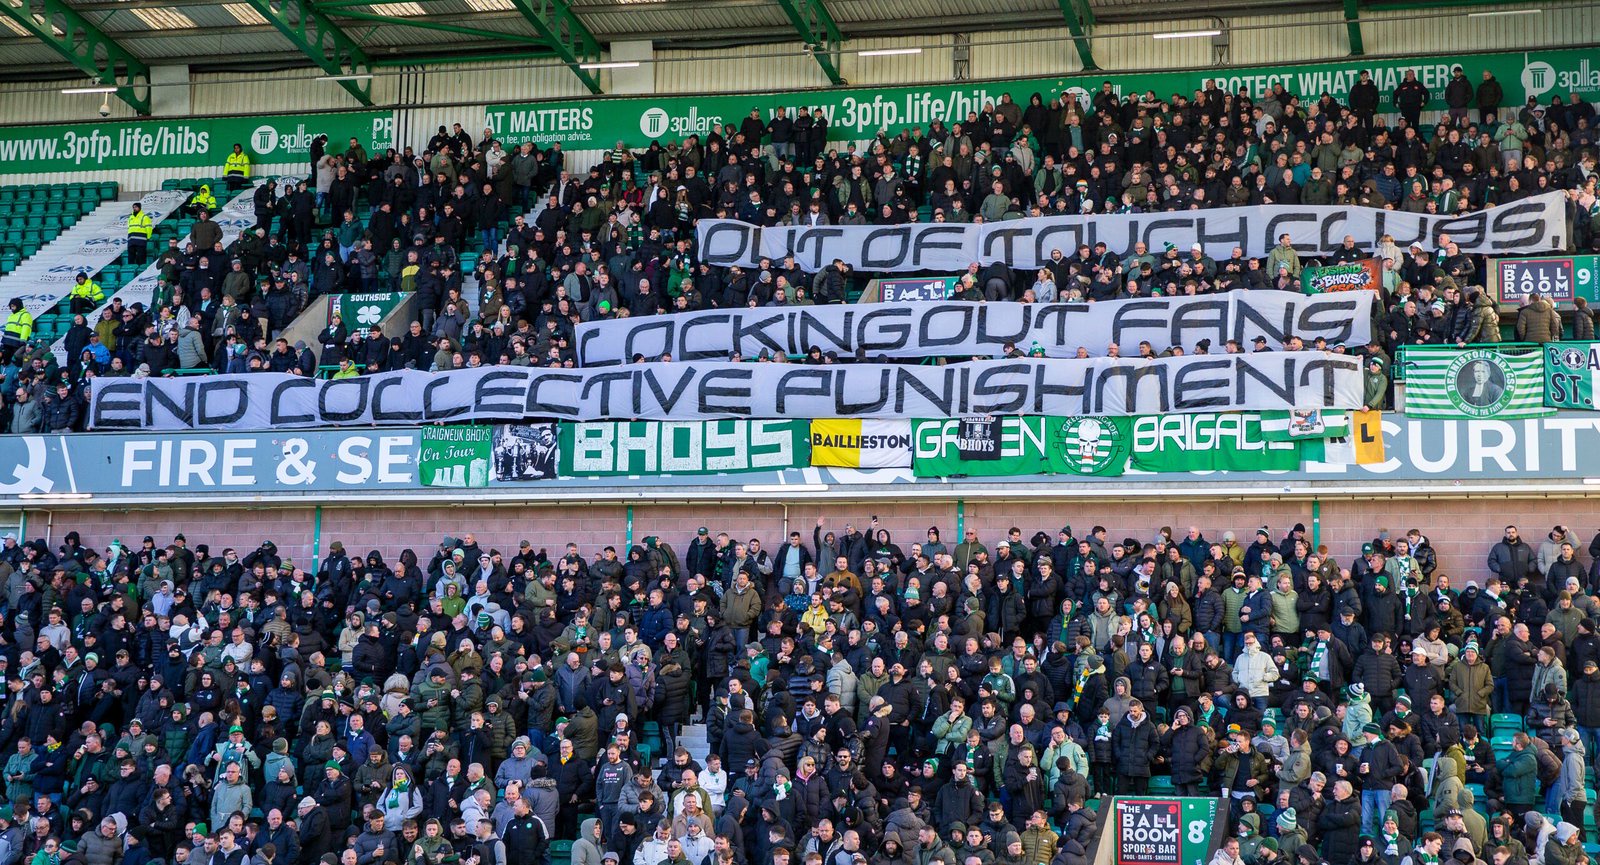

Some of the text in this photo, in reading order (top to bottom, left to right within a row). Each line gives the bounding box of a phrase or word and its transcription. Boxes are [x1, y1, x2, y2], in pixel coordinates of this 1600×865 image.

[510, 107, 593, 133] MATTERS
[506, 134, 519, 144] fee,
[521, 135, 530, 143] no
[532, 132, 566, 144] obligation
[567, 130, 592, 141] advice.
[0, 126, 209, 165] www.3pfp.life/hibs
[703, 222, 842, 267] OUT
[862, 225, 964, 267] OF
[984, 216, 1248, 267] TOUCH
[1504, 268, 1566, 281] BALL
[1577, 268, 1591, 285] 9
[1504, 280, 1568, 293] ROOM
[350, 292, 391, 302] SOUTHSIDE
[1113, 300, 1356, 347] FANS
[94, 357, 1359, 428] END COLLECTIVE PUNISHMENT
[1551, 372, 1592, 404] ST.
[423, 426, 491, 441] CRAIGNEUK BHOYS
[813, 433, 911, 449] BAILLIESTON
[573, 420, 793, 472] BHOYS
[960, 438, 995, 452] BHOYS
[422, 445, 475, 462] On Tour
[121, 439, 256, 487] FIRE
[276, 437, 317, 485] &
[1124, 805, 1141, 814] THE
[1123, 813, 1176, 828] BALL
[1123, 828, 1178, 843] ROOM
[1188, 820, 1207, 844] 8
[1123, 844, 1176, 854] SPORTS BAR
